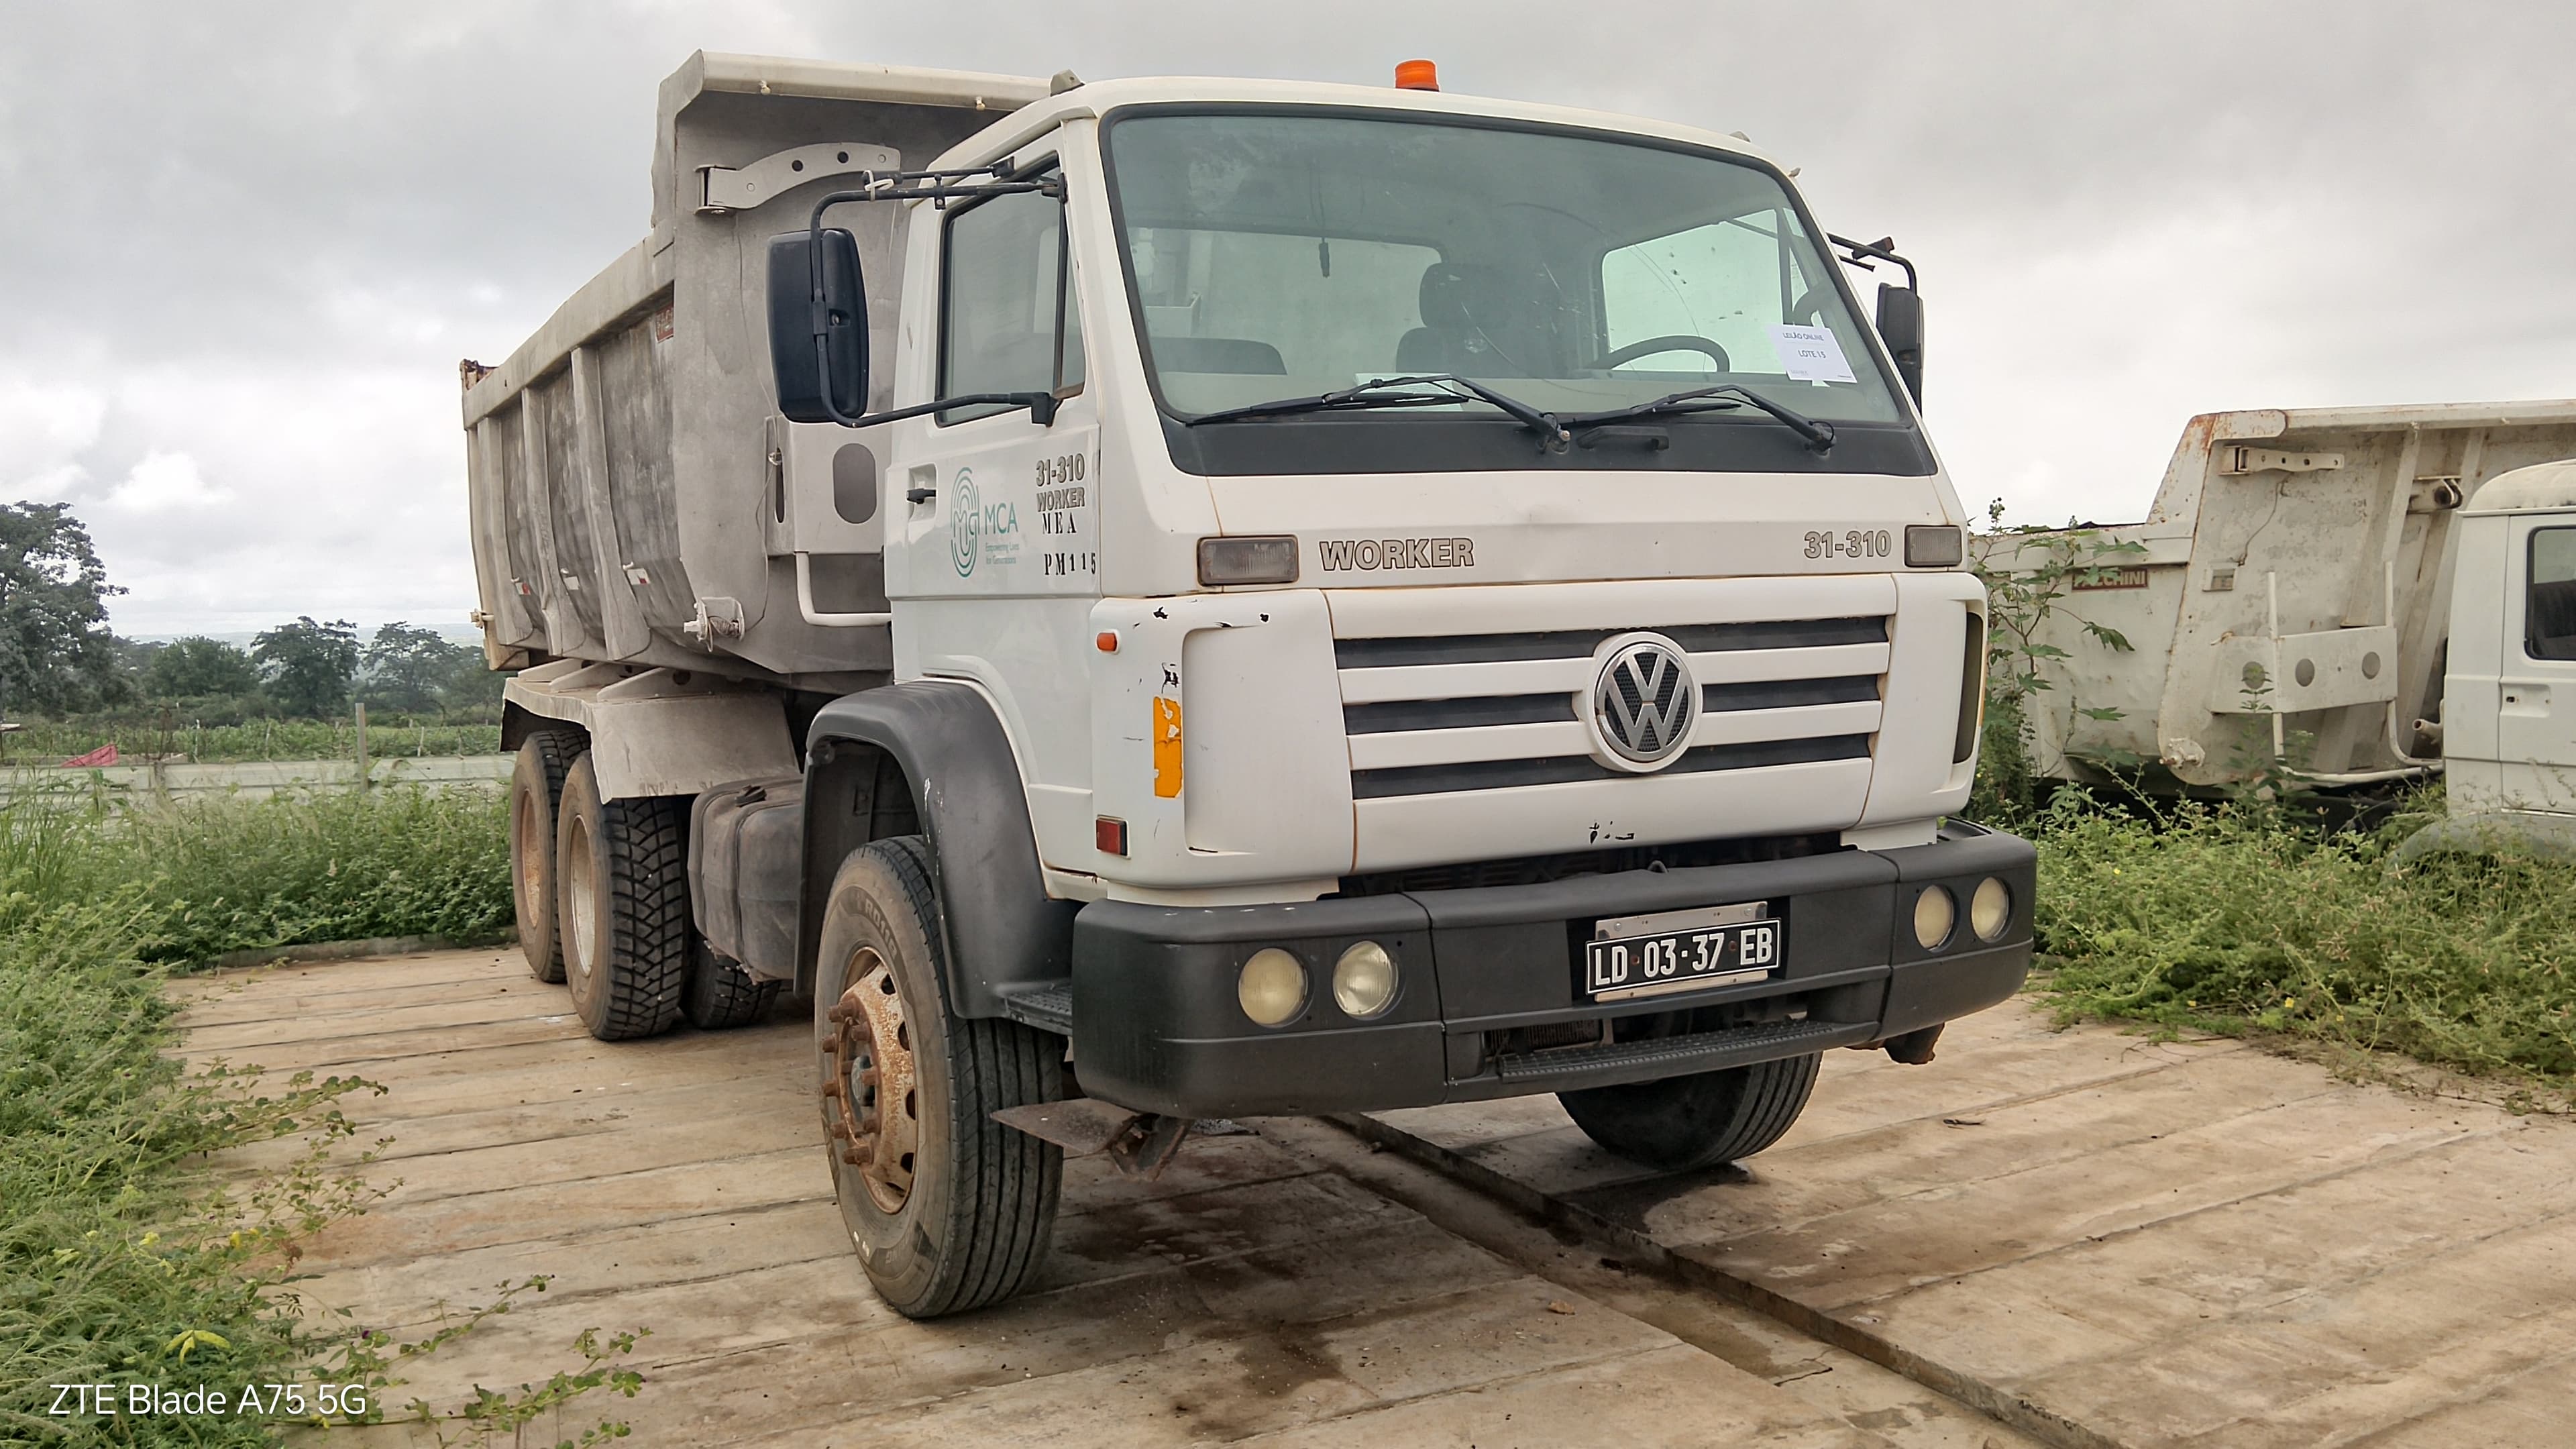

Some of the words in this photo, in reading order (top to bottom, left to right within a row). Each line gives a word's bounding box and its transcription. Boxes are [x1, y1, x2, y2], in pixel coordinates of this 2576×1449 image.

[1798, 350, 1817, 358] LOTE
[1817, 350, 1826, 358] 15
[1036, 453, 1085, 487] 31-310
[1036, 487, 1085, 512] WORKER
[984, 502, 1018, 535] MCA
[1319, 537, 1474, 571] WORKER
[1804, 530, 1891, 558] 31-310
[1595, 945, 1627, 986] LD
[1739, 927, 1772, 966] EB
